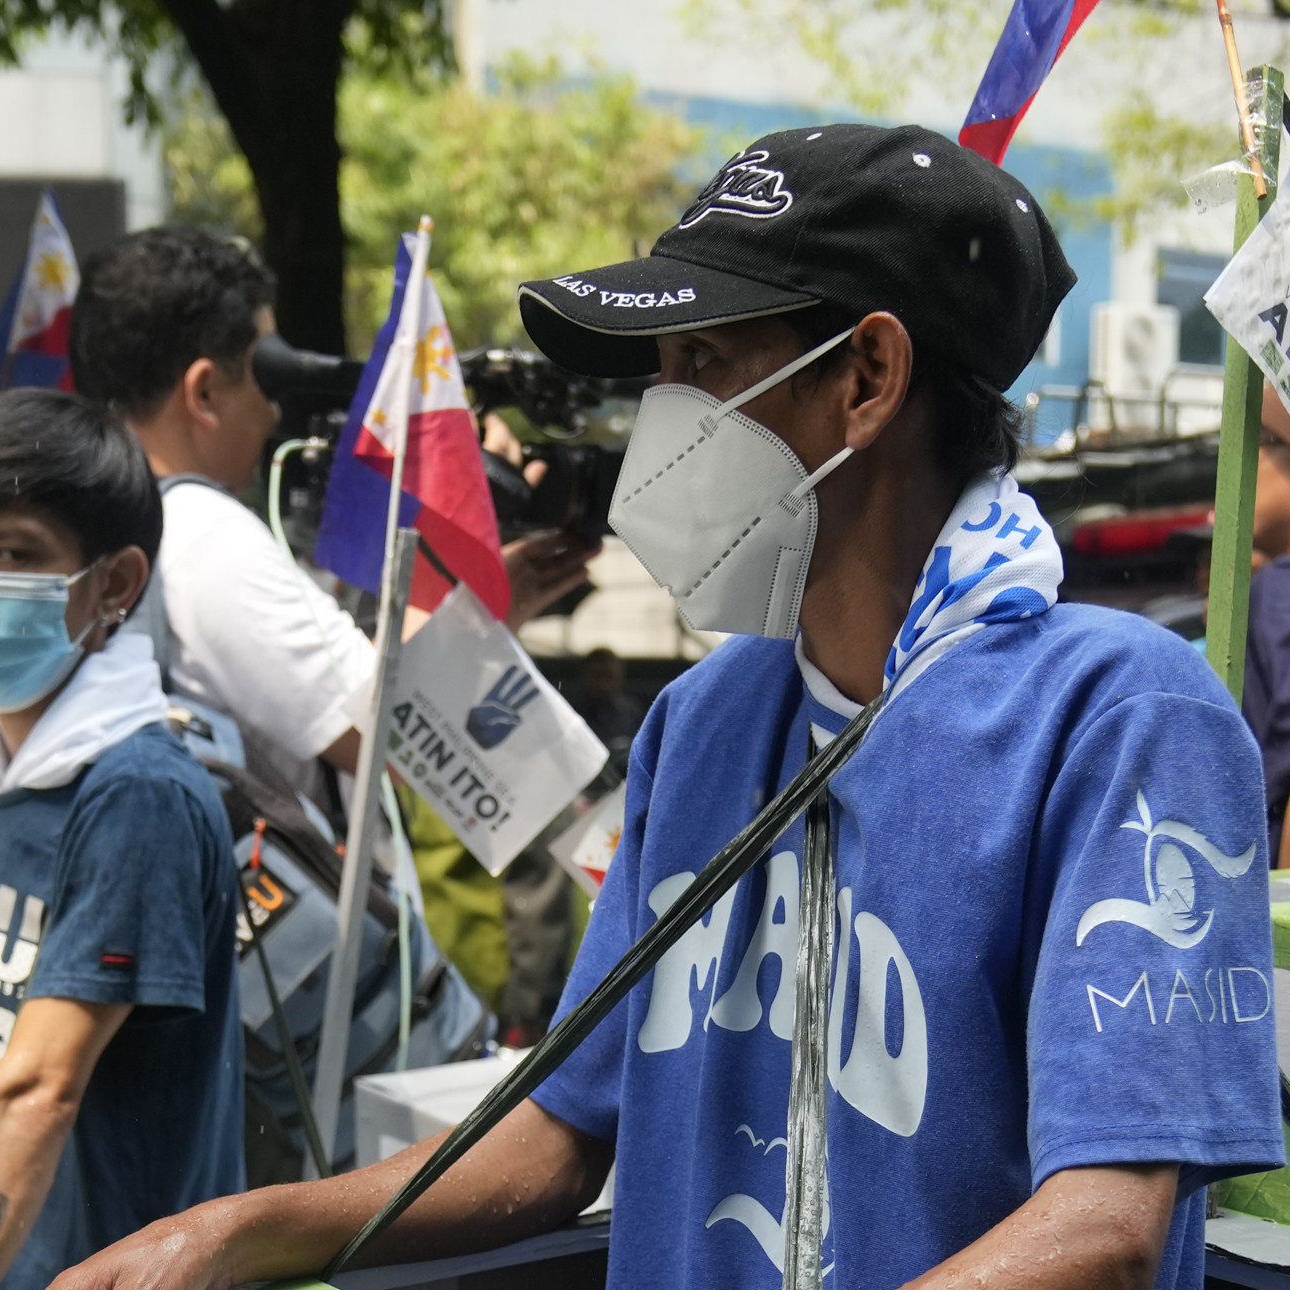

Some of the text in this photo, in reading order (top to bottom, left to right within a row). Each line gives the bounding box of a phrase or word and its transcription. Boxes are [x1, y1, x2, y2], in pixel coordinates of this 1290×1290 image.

[552, 276, 697, 308] LAS VEGAS
[393, 702, 512, 832] ATIN ITO!
[1086, 966, 1271, 1033] MASID
